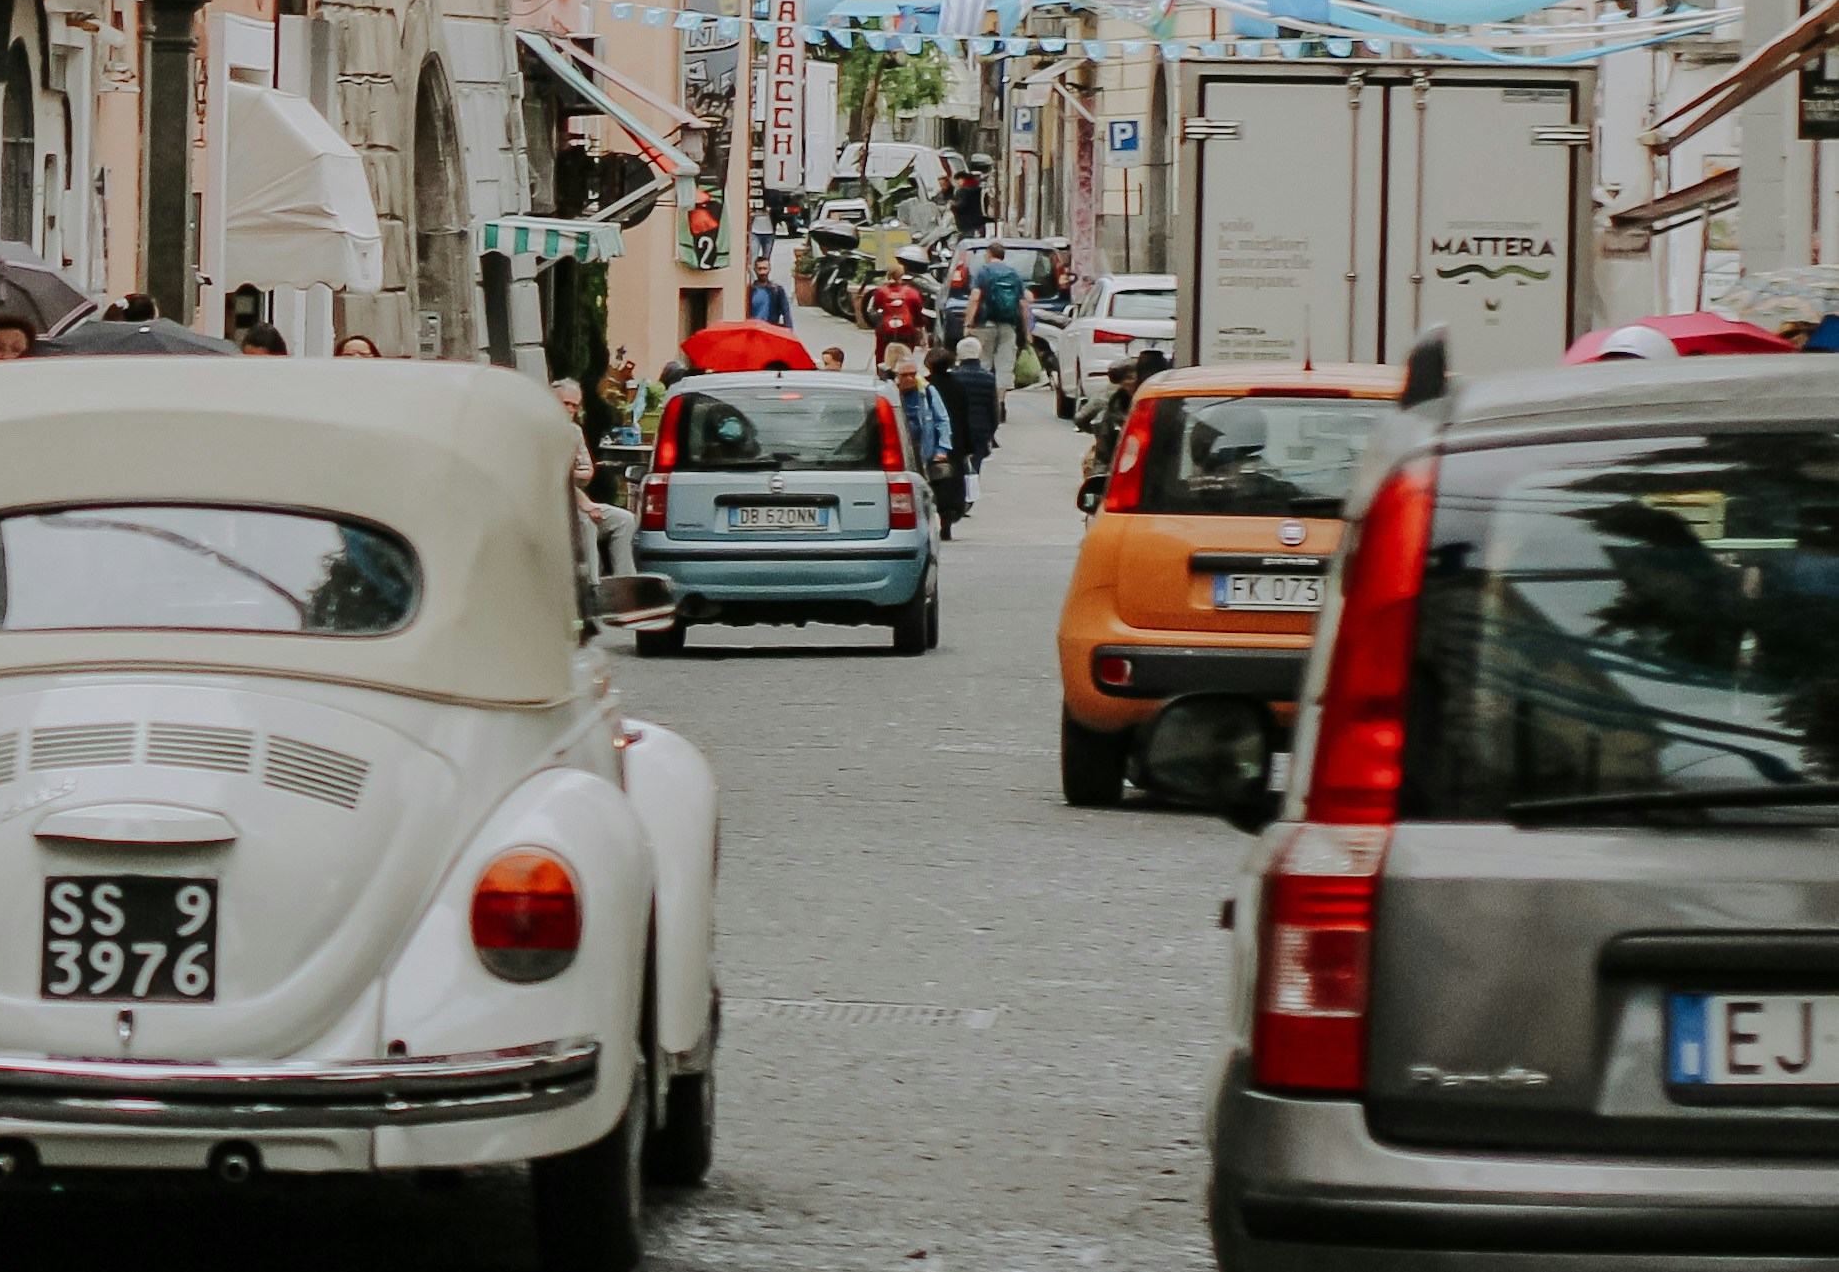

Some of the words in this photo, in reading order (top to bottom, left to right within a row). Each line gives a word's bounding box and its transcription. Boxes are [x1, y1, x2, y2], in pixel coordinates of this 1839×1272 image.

[1015, 107, 1032, 132] P
[1112, 123, 1135, 150] P
[697, 235, 716, 271] 2
[1429, 236, 1556, 257] MATTERA
[740, 508, 760, 525] DB
[1232, 577, 1265, 602] FK
[48, 882, 126, 938] SS
[174, 884, 213, 938] 9
[46, 940, 211, 997] 3976
[1725, 1001, 1814, 1076] EJ
